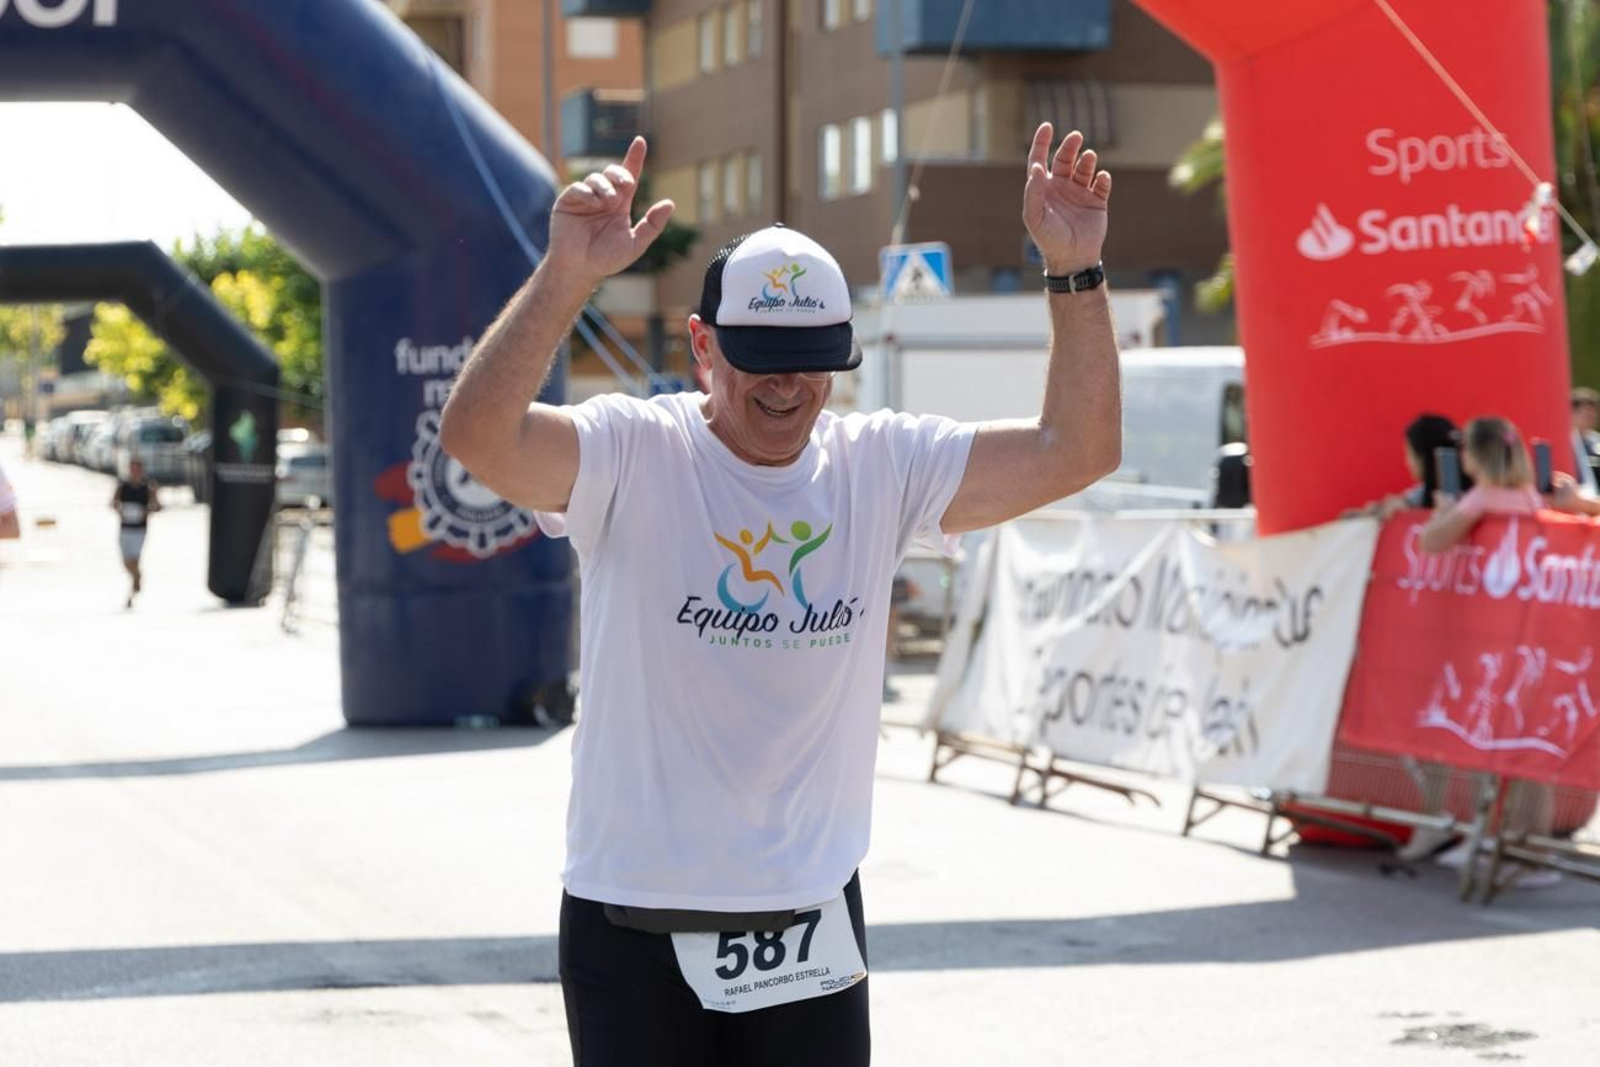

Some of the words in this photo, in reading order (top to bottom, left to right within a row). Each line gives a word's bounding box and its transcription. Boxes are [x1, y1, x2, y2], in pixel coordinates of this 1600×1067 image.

[1365, 127, 1511, 184] Sports
[748, 296, 786, 312] Equipo
[394, 335, 474, 375] fund
[677, 596, 779, 638] Equipo
[708, 635, 773, 649] JUNTOS
[782, 639, 800, 650] SE
[810, 633, 851, 648] PUEDE
[715, 909, 822, 980] 587
[724, 984, 753, 998] RAFAEL
[753, 974, 795, 991] PANCORBO
[795, 966, 831, 981] ESTRELLA
